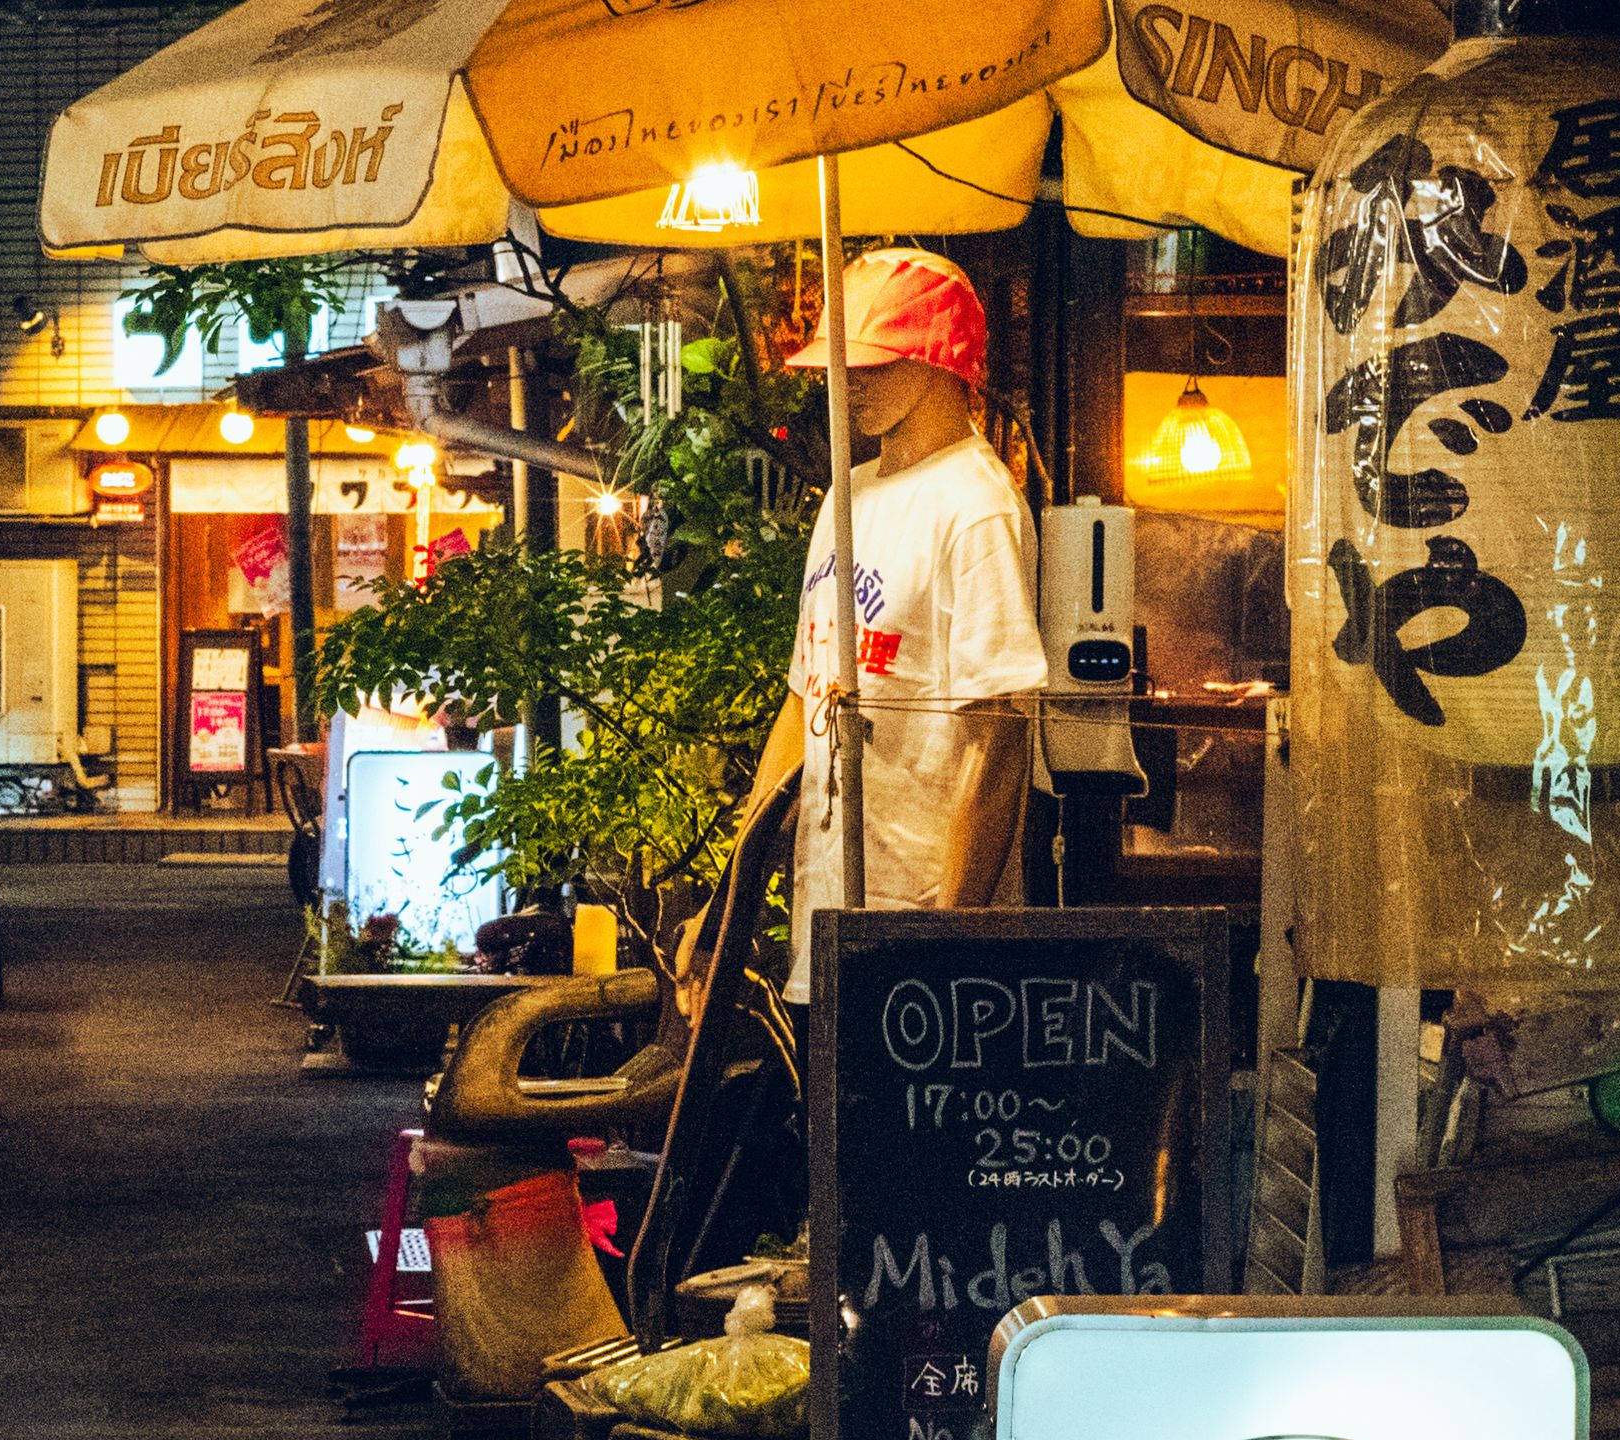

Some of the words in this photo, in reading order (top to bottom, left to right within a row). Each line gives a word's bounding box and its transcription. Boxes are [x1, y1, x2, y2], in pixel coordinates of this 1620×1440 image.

[1134, 4, 1384, 136] SINGH
[96, 101, 404, 208] เบียร์สิงห์
[882, 975, 1160, 1072] OPEN
[972, 1126, 1114, 1167] 25:00
[909, 1354, 981, 1402] 全席
